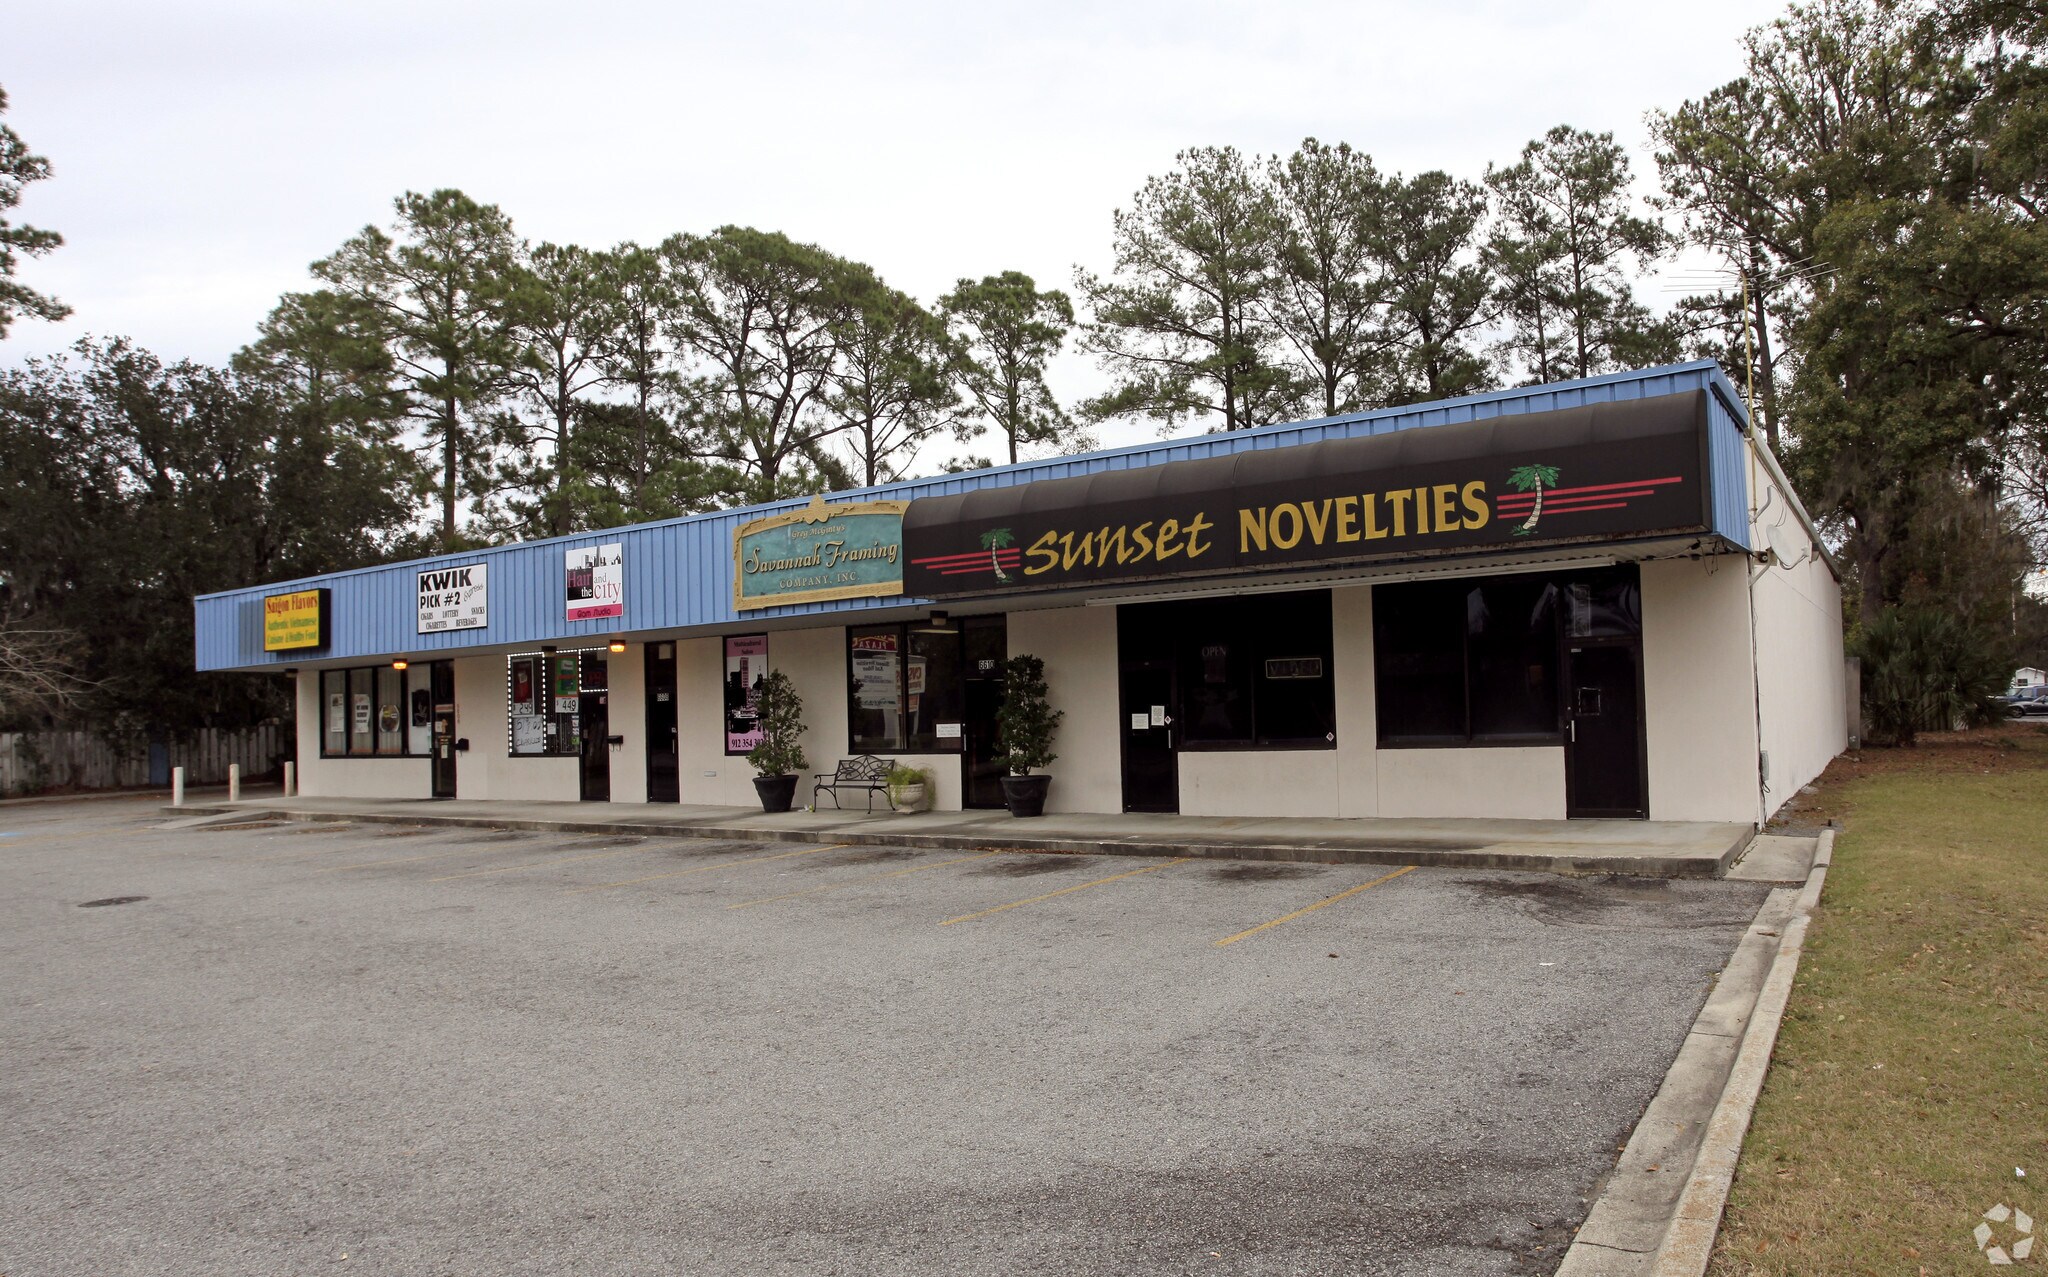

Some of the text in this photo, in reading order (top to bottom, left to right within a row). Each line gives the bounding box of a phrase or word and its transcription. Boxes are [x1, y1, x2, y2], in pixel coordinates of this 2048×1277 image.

[791, 529, 808, 540] Greg
[1023, 480, 1490, 576] Sunset NOVELTIES
[744, 540, 899, 575] Savannah Framing
[420, 568, 471, 593] KWIK
[567, 571, 607, 588] Hair and
[779, 571, 861, 589] COMPANY, INC.
[420, 591, 460, 609] PICK #2
[581, 579, 621, 604] the city
[267, 594, 317, 617] Saigon Flavors
[421, 606, 485, 621] CIGARS LOTTERY SNACKS
[426, 617, 477, 630] CIGARETTES BEVERAGES
[1201, 646, 1227, 657] OPEN
[731, 739, 741, 748] 912
[742, 739, 752, 748] 354
